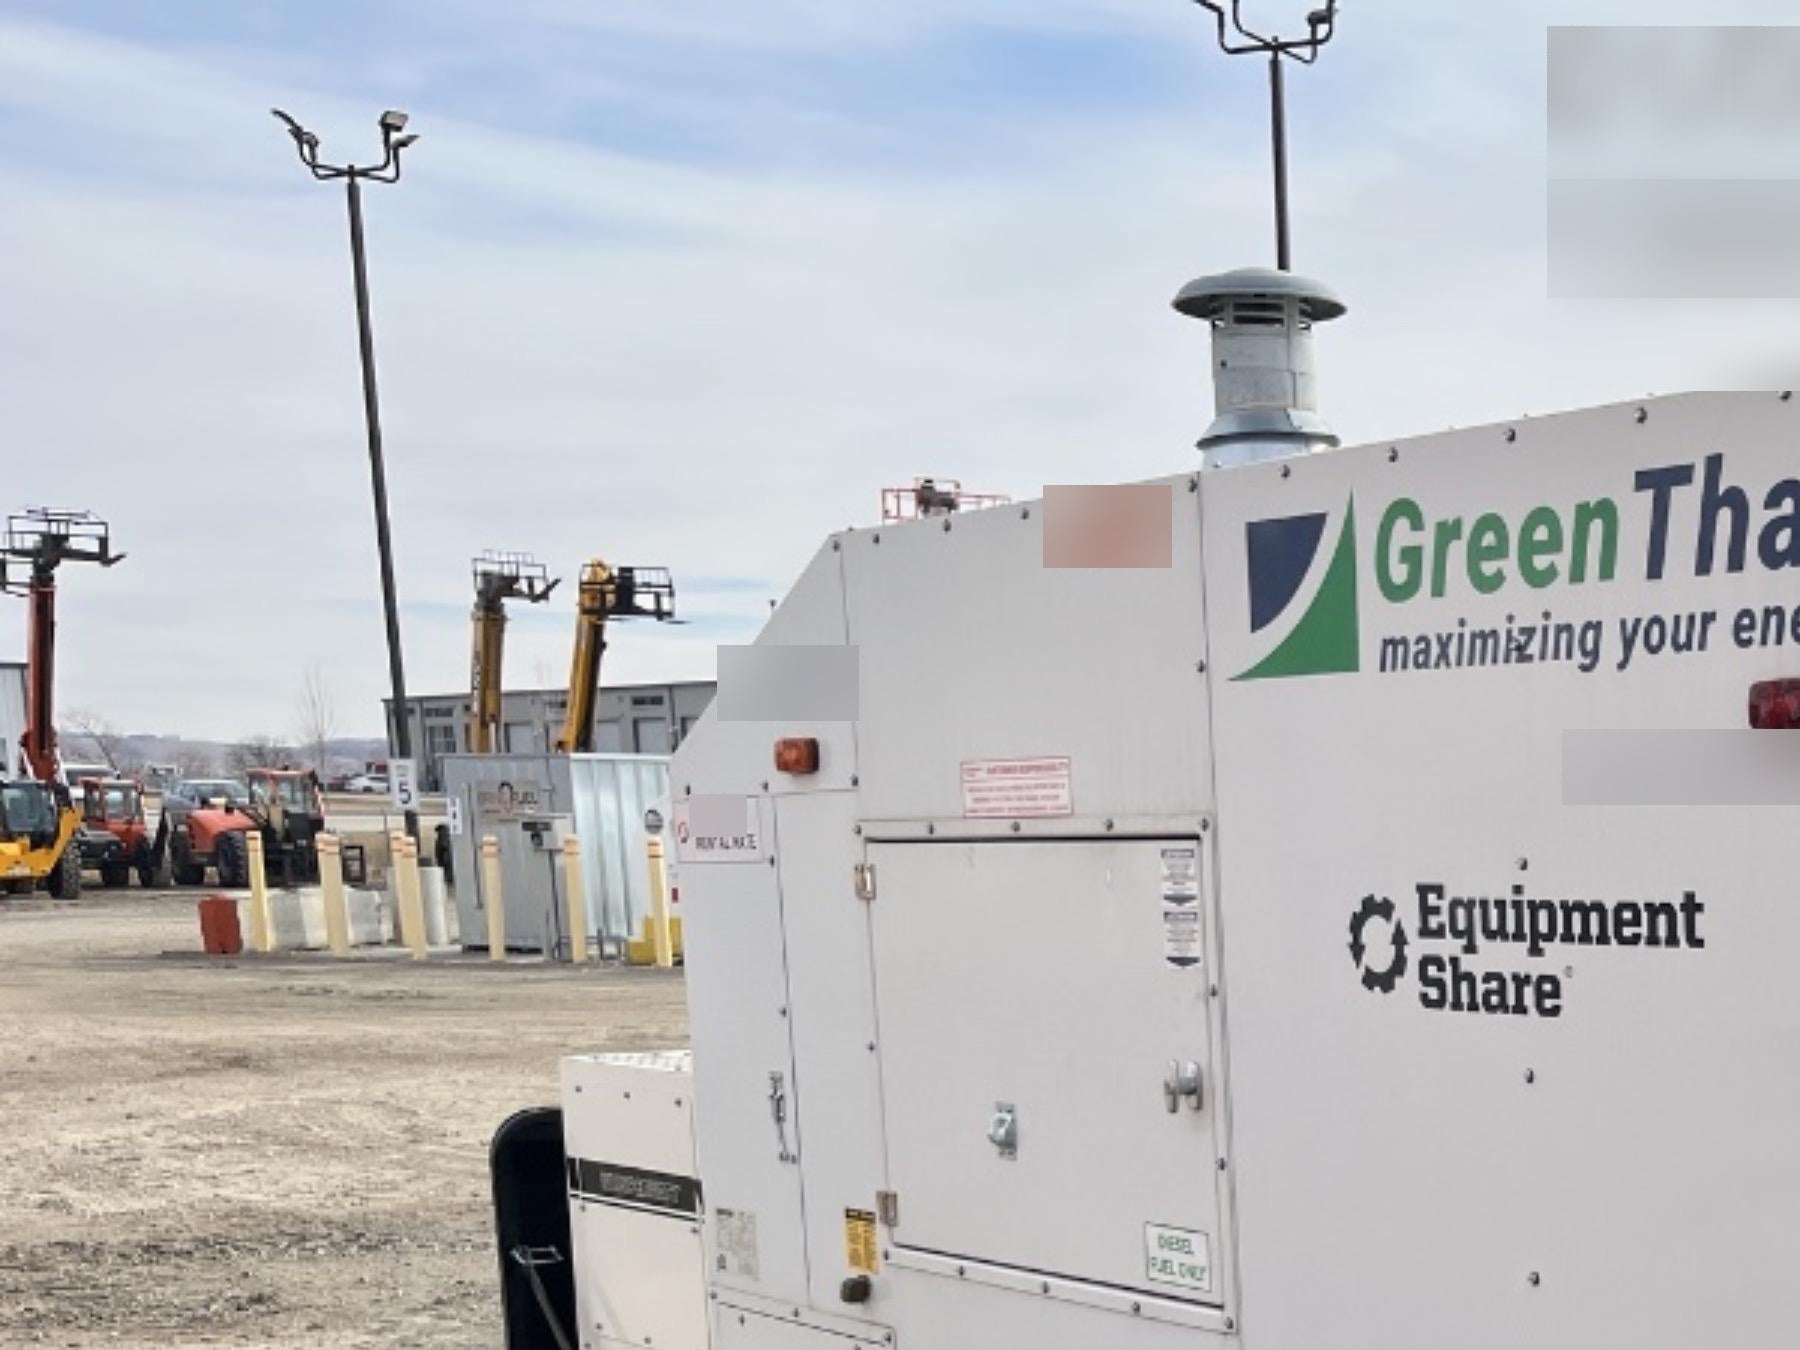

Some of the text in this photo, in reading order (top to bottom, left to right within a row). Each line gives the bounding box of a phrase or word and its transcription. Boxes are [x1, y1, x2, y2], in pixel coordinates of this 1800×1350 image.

[1378, 610, 1604, 673] maximizing
[1616, 611, 1718, 673] your
[1416, 882, 1706, 958] Equipment
